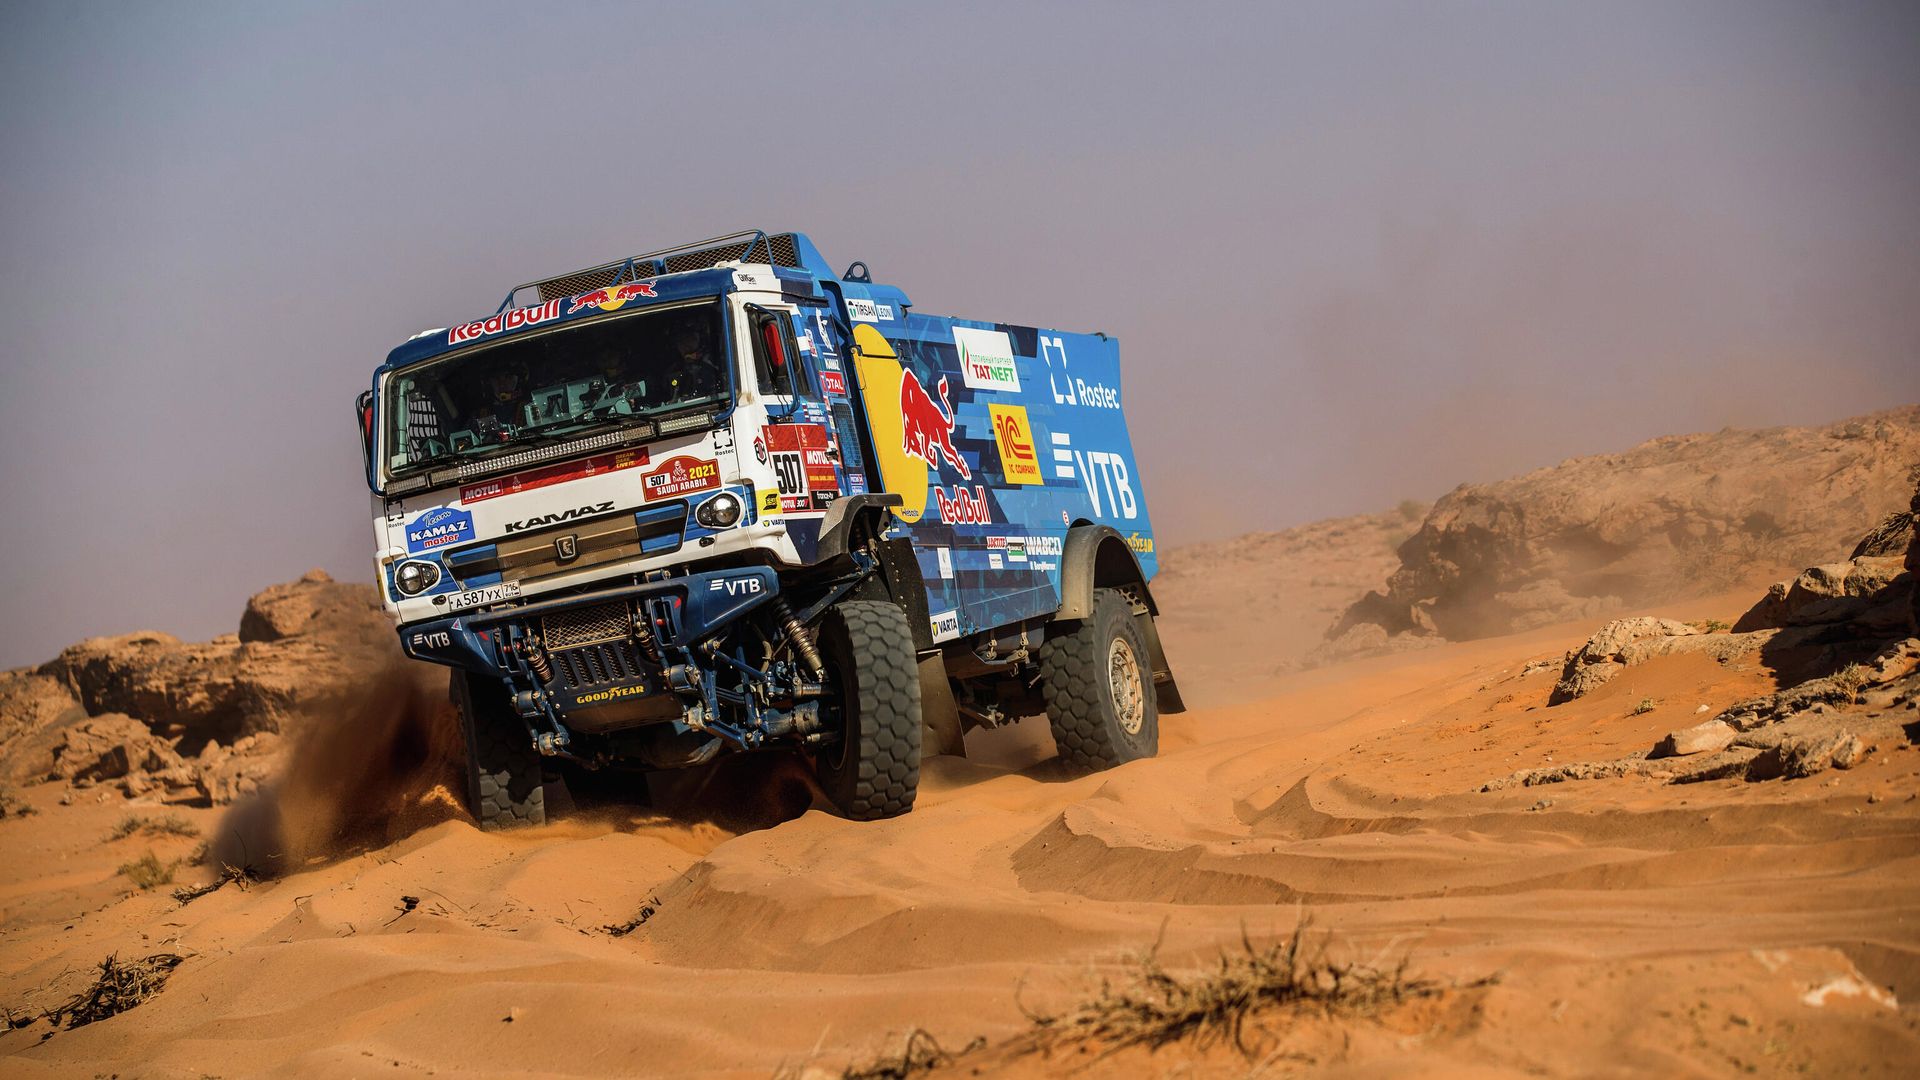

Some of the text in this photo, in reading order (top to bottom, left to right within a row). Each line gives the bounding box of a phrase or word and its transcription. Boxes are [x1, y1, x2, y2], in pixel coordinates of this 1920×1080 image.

[449, 298, 562, 345] Red Bull
[820, 374, 844, 390] TOTAL
[972, 364, 1014, 382] TATNEFT
[1076, 378, 1120, 409] Rostec
[689, 464, 716, 480] 2021
[772, 454, 804, 494] 507
[1015, 464, 1036, 475] COMPANY
[650, 474, 666, 486] 507
[656, 478, 708, 496] SAUDI ARABIA
[1074, 450, 1137, 520] VTB
[464, 484, 501, 500] MOTUL
[934, 484, 992, 526] Red Bull
[388, 521, 405, 529] Rostec
[423, 510, 452, 527] Team
[505, 500, 615, 533] KAMAZ
[410, 520, 468, 543] KAMAZ
[424, 533, 460, 548] master
[1025, 536, 1062, 556] WABCO
[724, 577, 761, 596] VTB
[938, 618, 958, 634] VARTA
[424, 631, 450, 648] VTB
[576, 685, 644, 704] GOODYEAR
